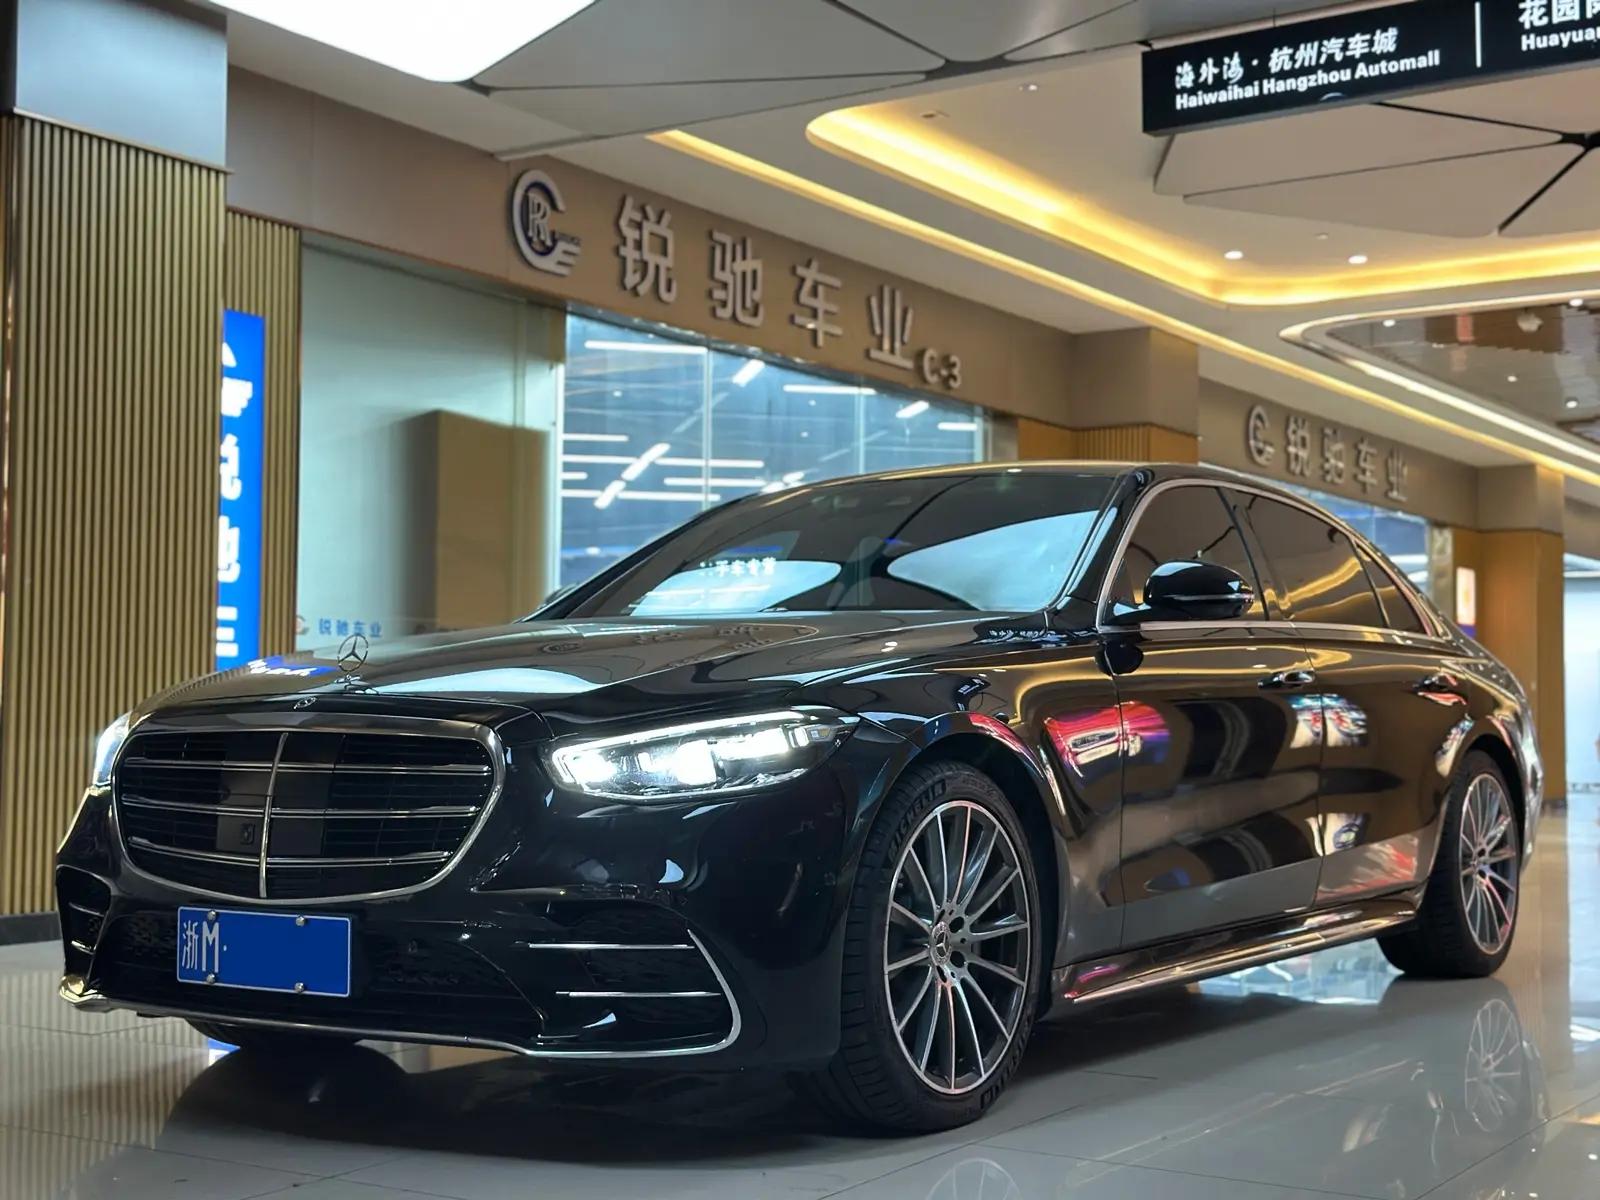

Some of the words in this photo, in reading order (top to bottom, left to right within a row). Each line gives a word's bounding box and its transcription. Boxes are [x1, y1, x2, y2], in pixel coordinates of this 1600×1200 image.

[1175, 81, 1260, 111] Haiwaihai
[1263, 66, 1351, 95] Hangzhou
[1355, 49, 1441, 78] Automall
[617, 195, 915, 371] 锐驰车业
[921, 347, 962, 389] C-3
